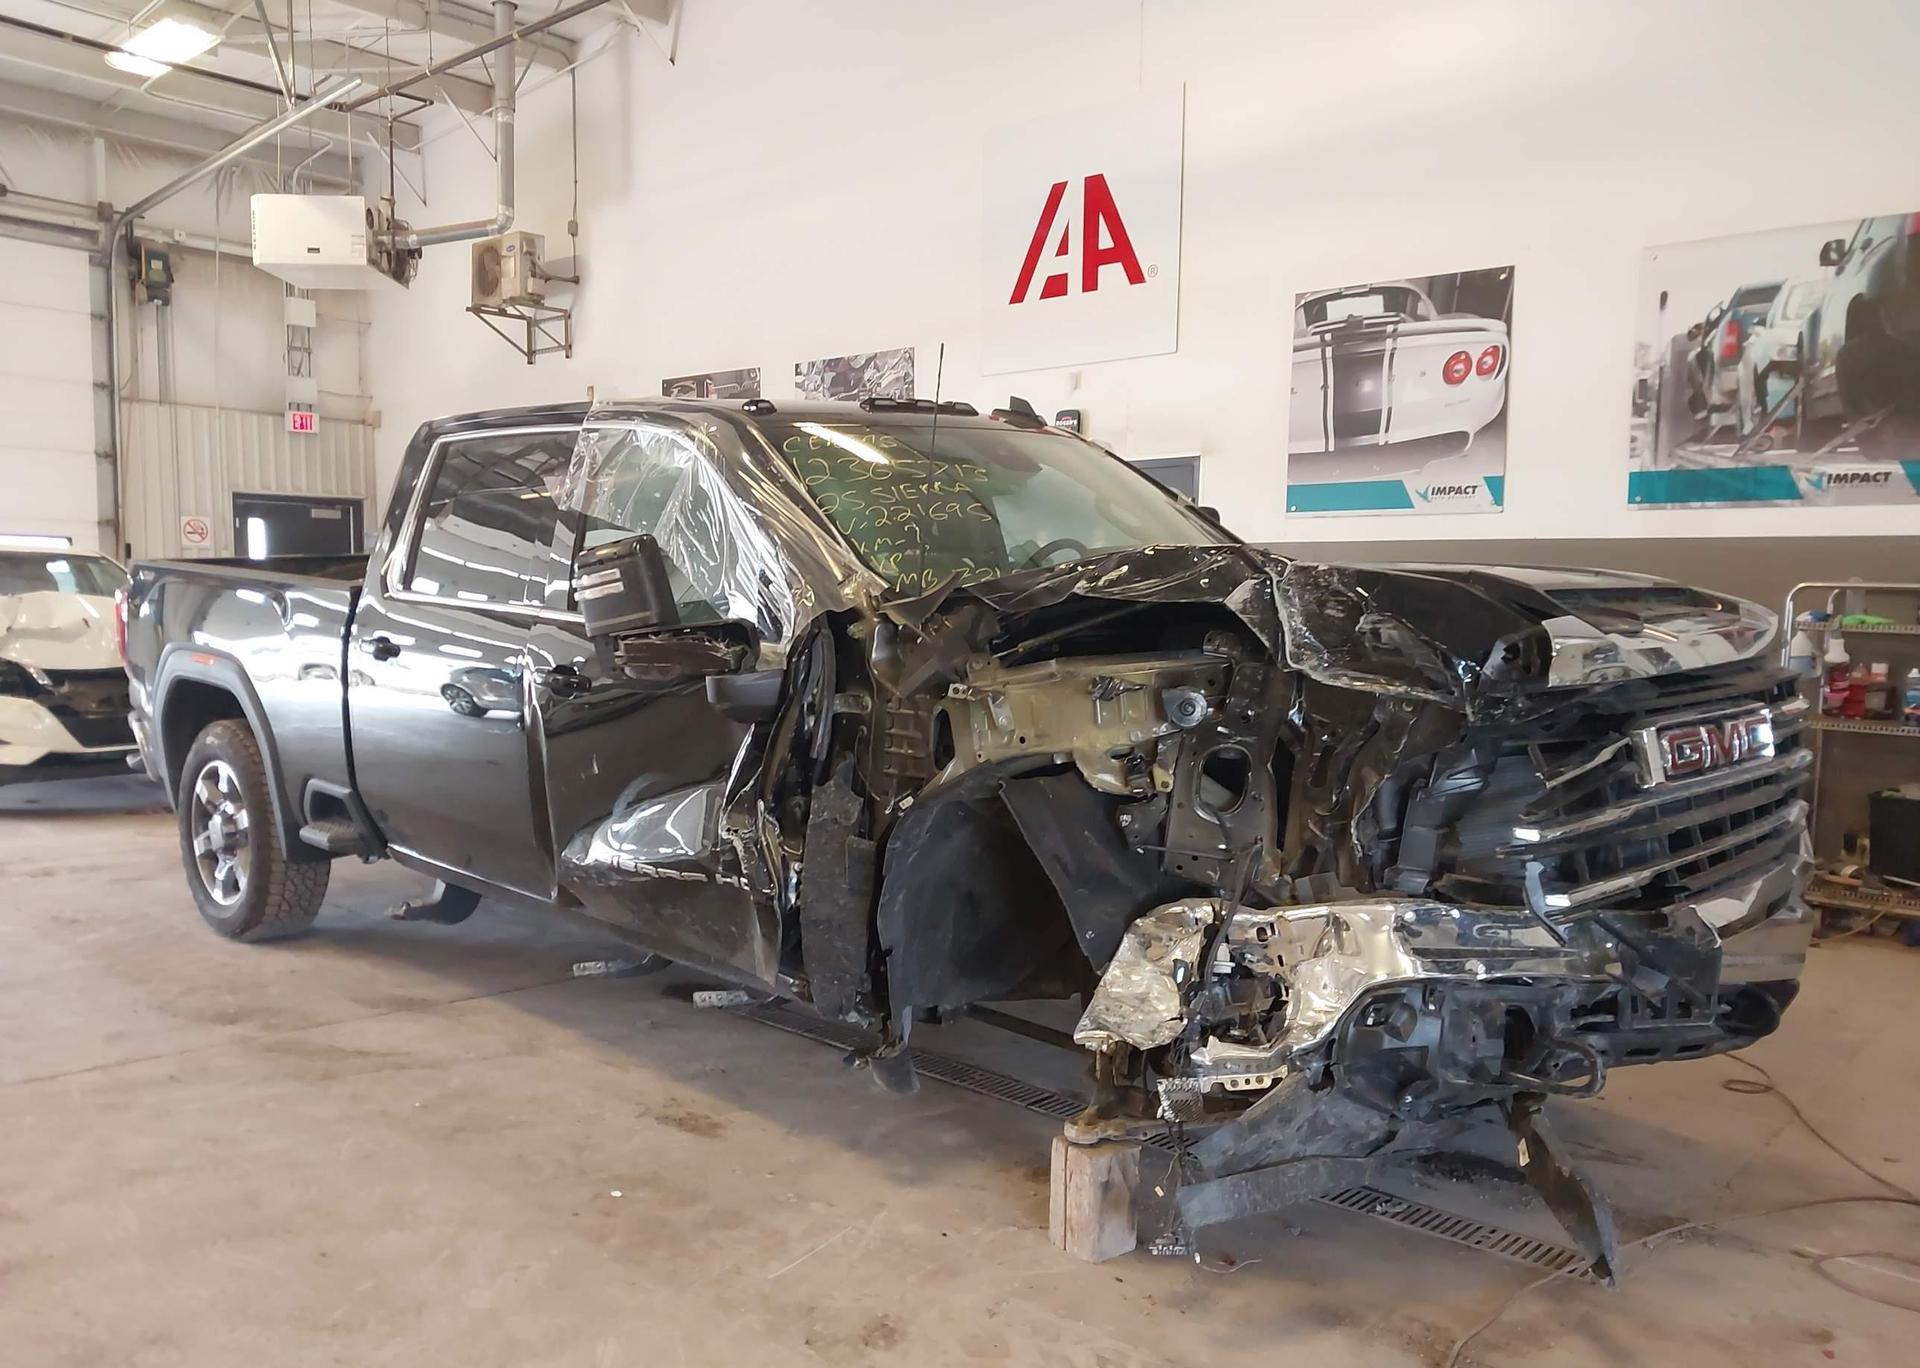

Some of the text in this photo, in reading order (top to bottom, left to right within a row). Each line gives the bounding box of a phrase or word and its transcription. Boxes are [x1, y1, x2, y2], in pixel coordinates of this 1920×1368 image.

[1827, 471, 1892, 485] IMPACT
[870, 481, 973, 503] SIERRA
[1431, 485, 1478, 496] IMPACT
[1660, 711, 1775, 776] GMC
